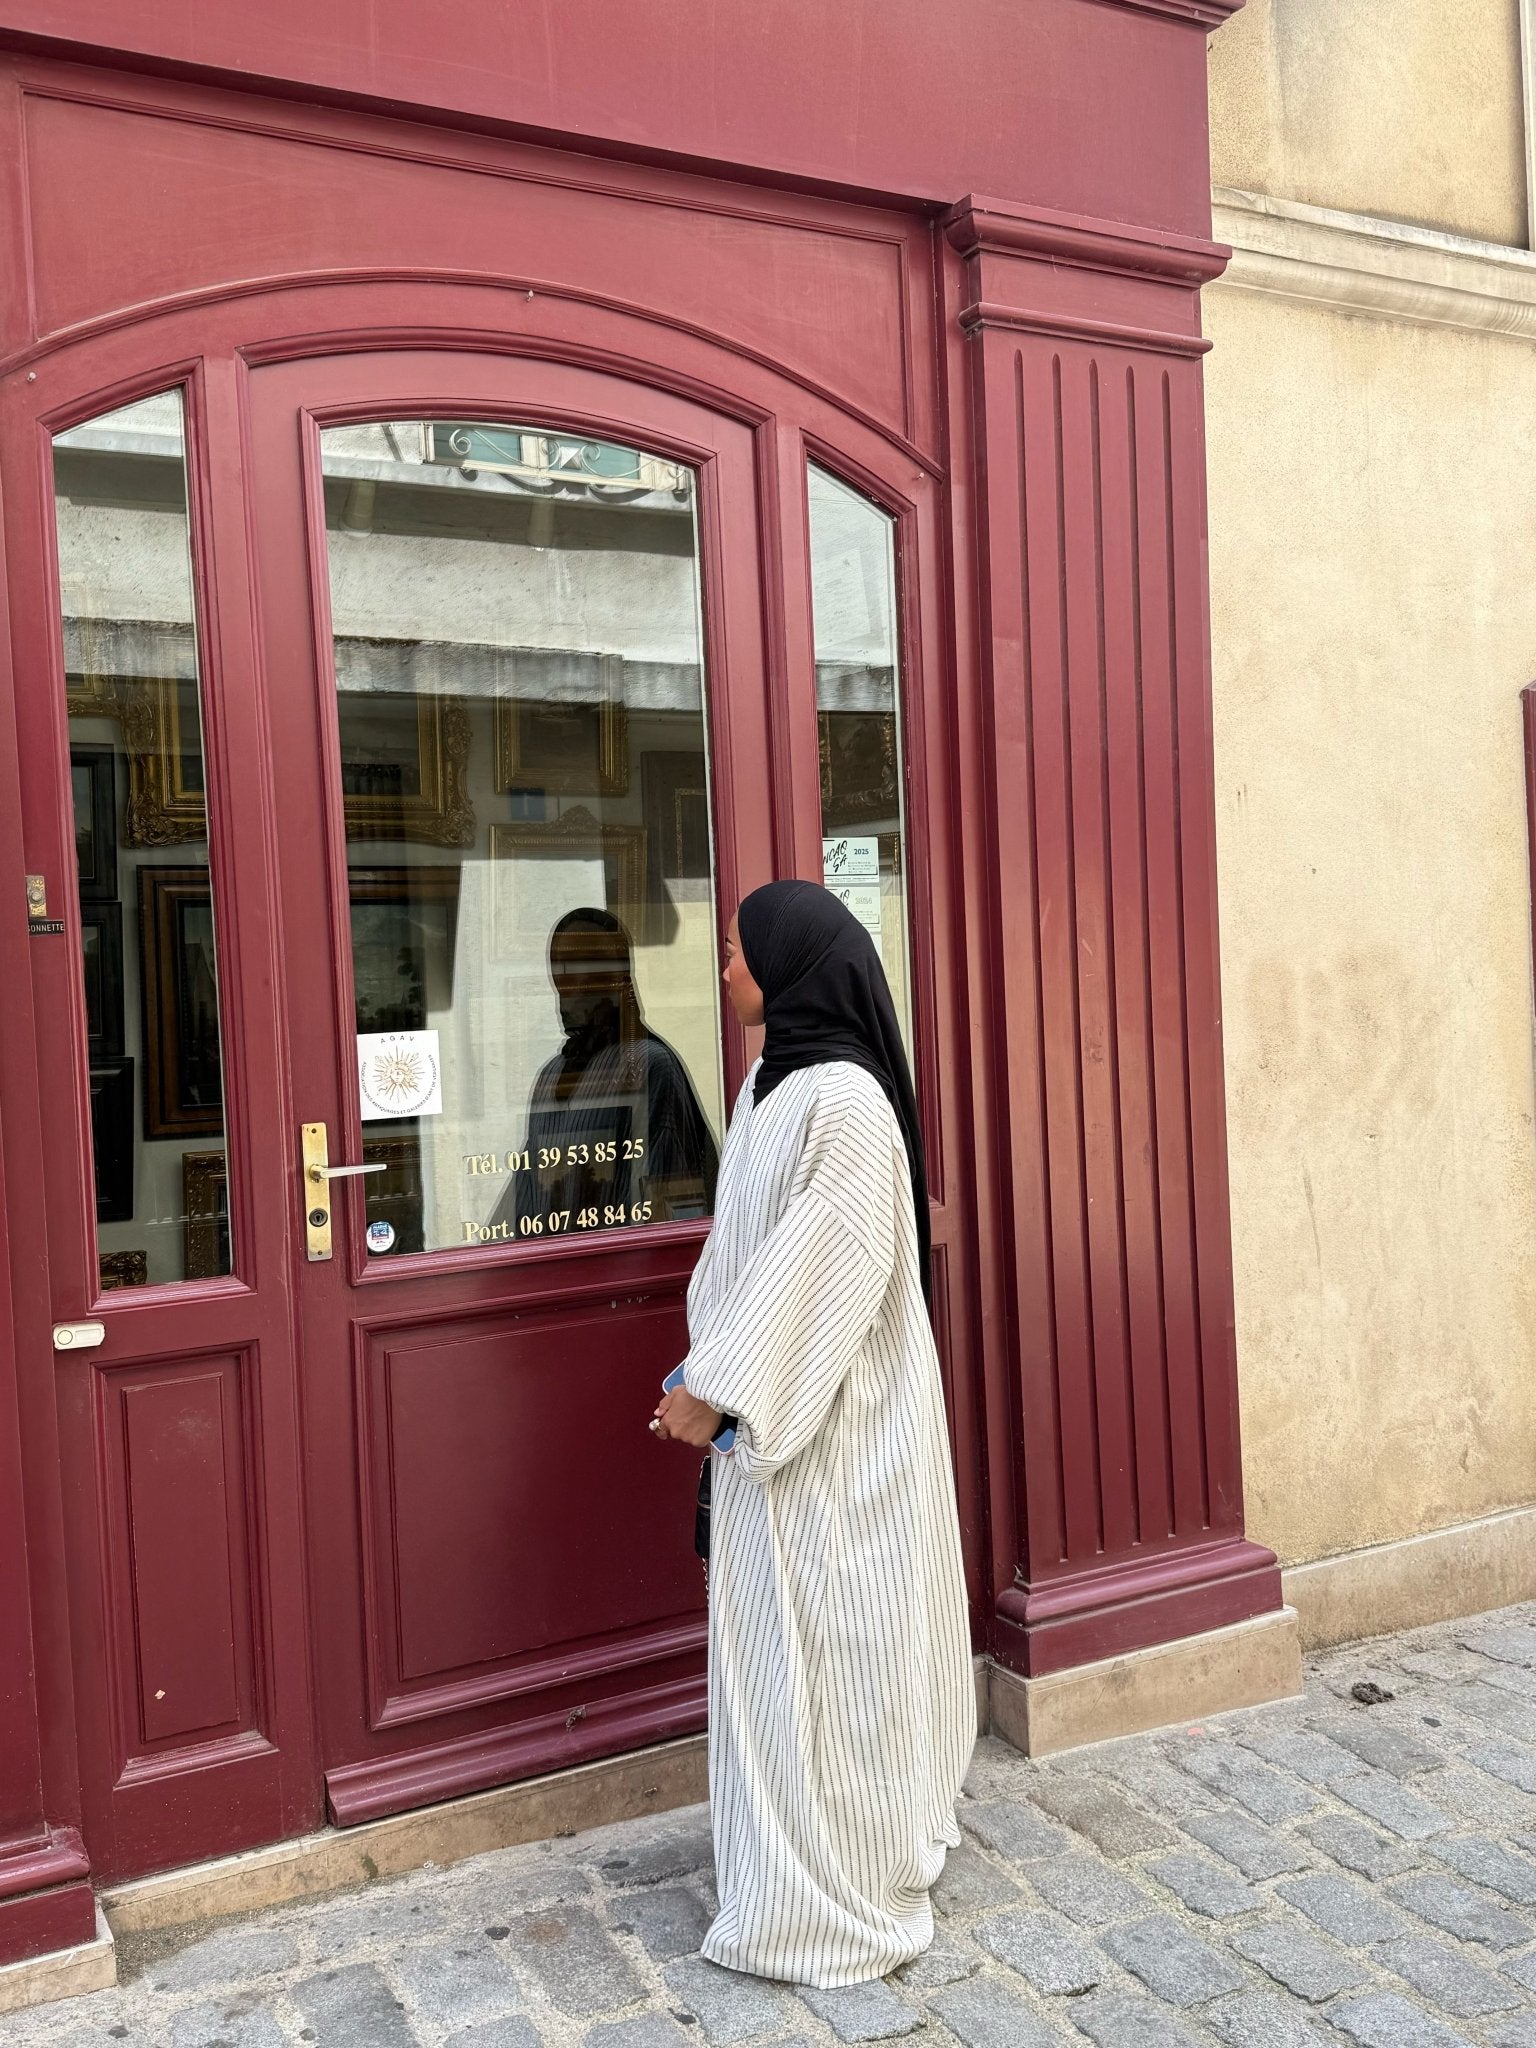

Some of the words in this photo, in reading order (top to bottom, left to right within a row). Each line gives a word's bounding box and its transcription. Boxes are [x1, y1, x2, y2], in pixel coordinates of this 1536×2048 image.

[380, 1035, 414, 1044] AGAV
[465, 1153, 503, 1176] Tél.
[508, 1150, 532, 1172] 01
[538, 1147, 561, 1169] 39
[567, 1144, 590, 1166] 53
[594, 1141, 617, 1163] 85
[622, 1138, 645, 1160] 25
[465, 1219, 515, 1243] Port.
[520, 1214, 543, 1236] 06
[548, 1210, 571, 1232] 07
[576, 1207, 599, 1228] 48
[604, 1203, 626, 1225] 84
[631, 1200, 652, 1221] 65
